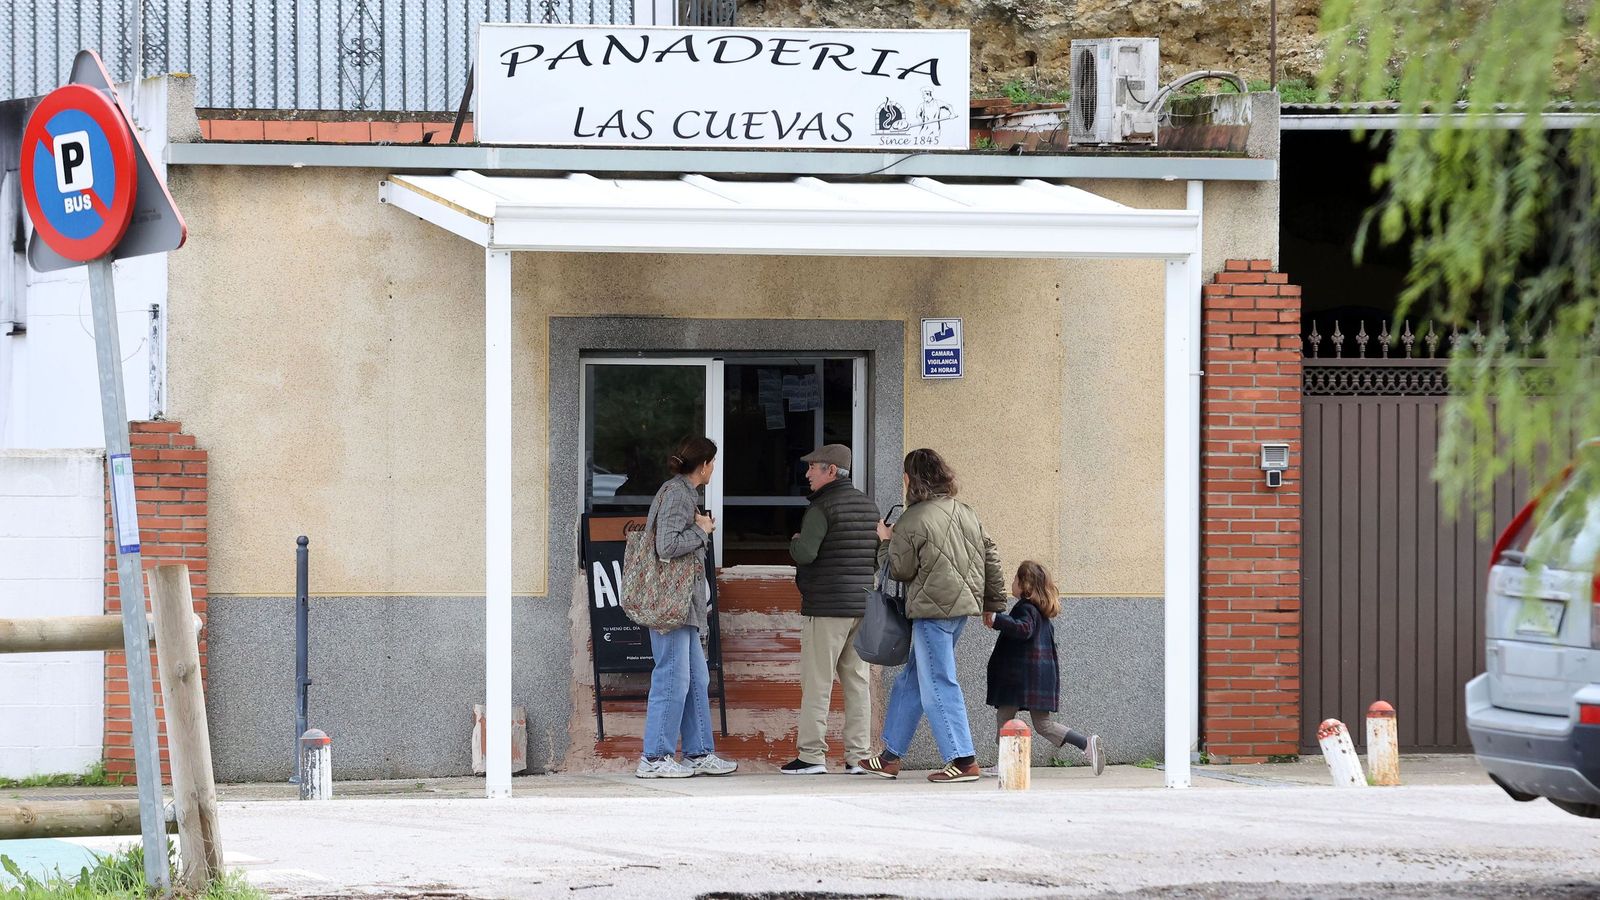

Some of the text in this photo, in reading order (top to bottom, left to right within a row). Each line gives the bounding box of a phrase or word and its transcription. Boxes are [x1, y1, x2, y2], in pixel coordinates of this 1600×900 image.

[500, 34, 942, 87] PANADERIA
[572, 106, 855, 143] LAS CUEVAS
[880, 136, 940, 146] Since 1845
[61, 141, 85, 185] P
[64, 194, 92, 214] BUS
